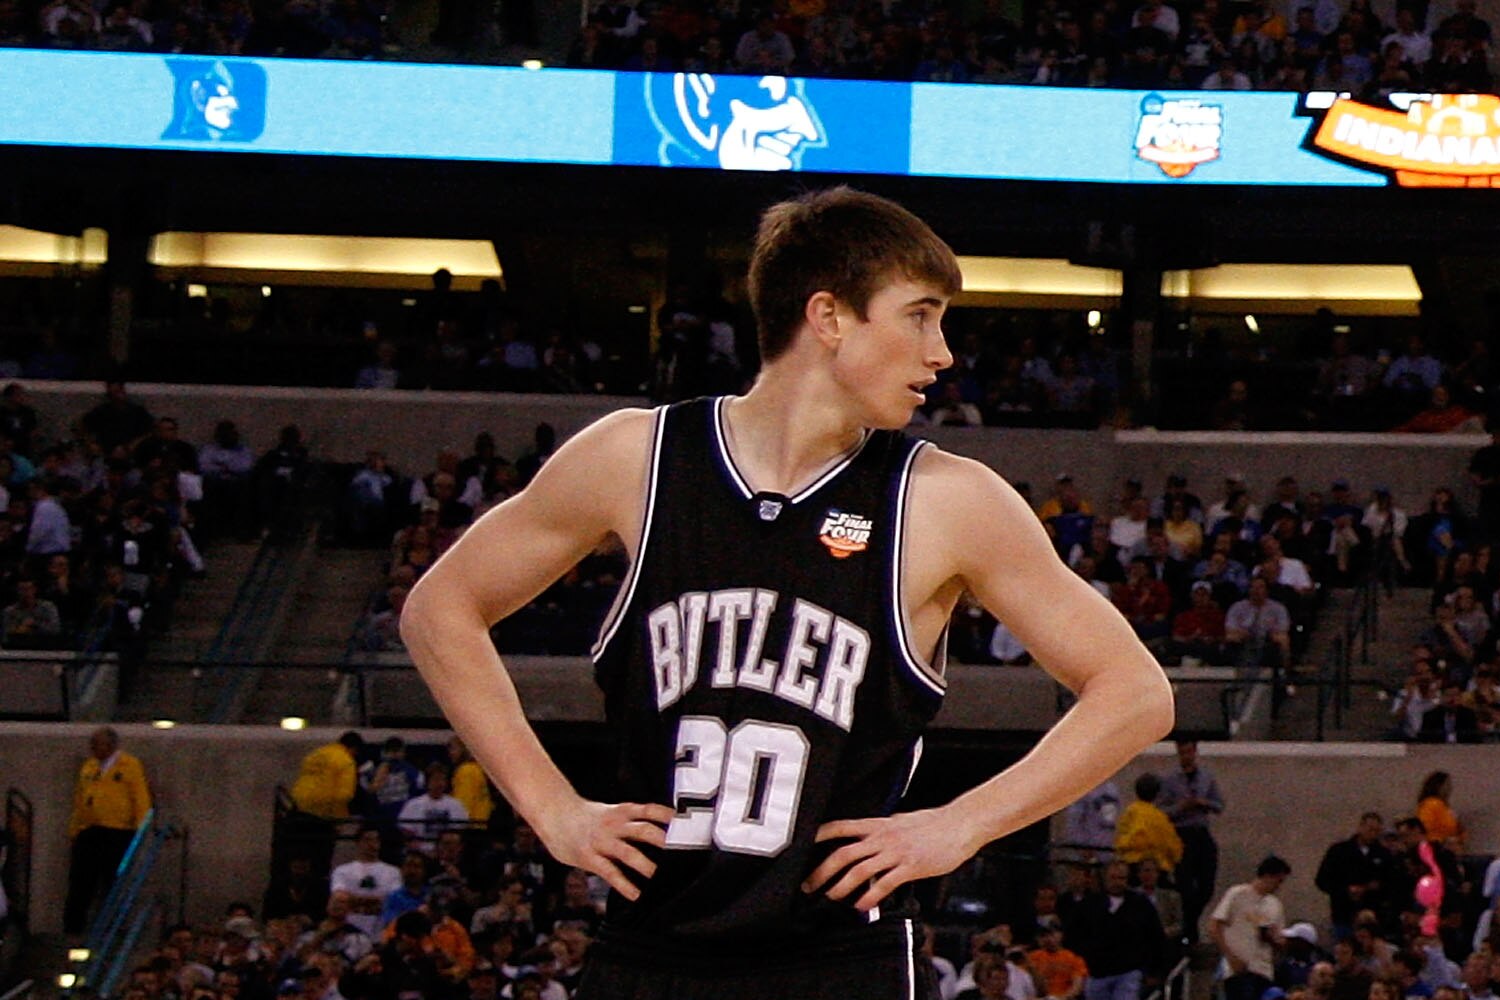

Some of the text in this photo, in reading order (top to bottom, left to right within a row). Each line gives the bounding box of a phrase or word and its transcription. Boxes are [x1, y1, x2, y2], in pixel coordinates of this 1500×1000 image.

[820, 518, 871, 543] FOUR
[648, 587, 872, 733] BUTLER
[663, 715, 810, 858] 20
